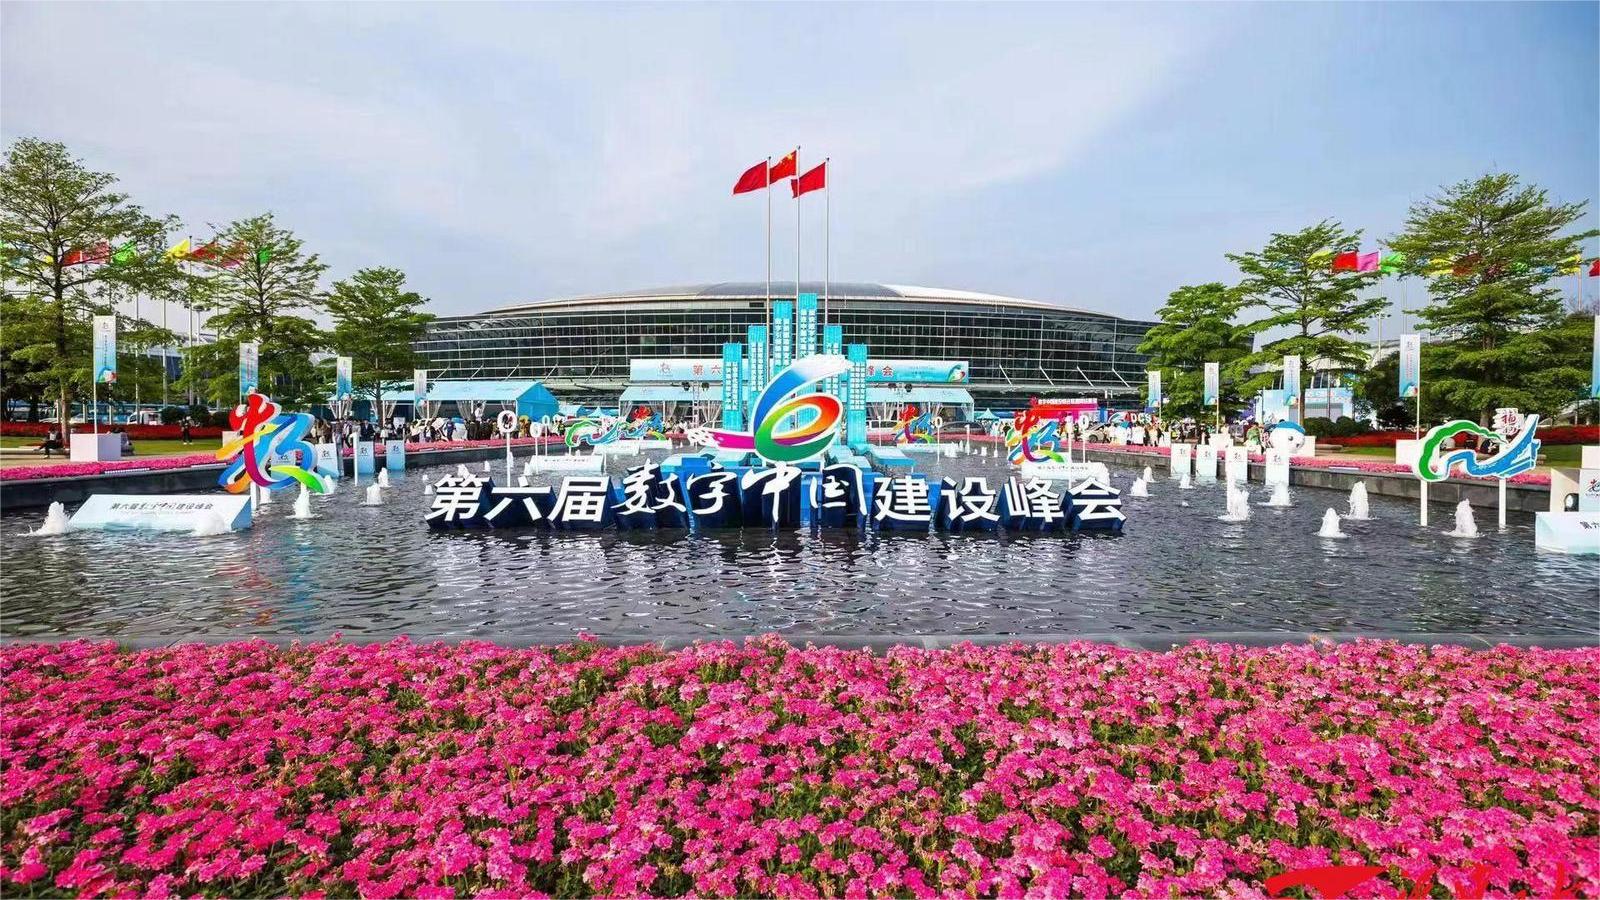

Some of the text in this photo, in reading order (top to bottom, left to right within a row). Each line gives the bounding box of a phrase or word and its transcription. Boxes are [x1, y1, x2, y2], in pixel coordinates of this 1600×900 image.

[425, 459, 1126, 522] 第六届数字中国建设峰会
